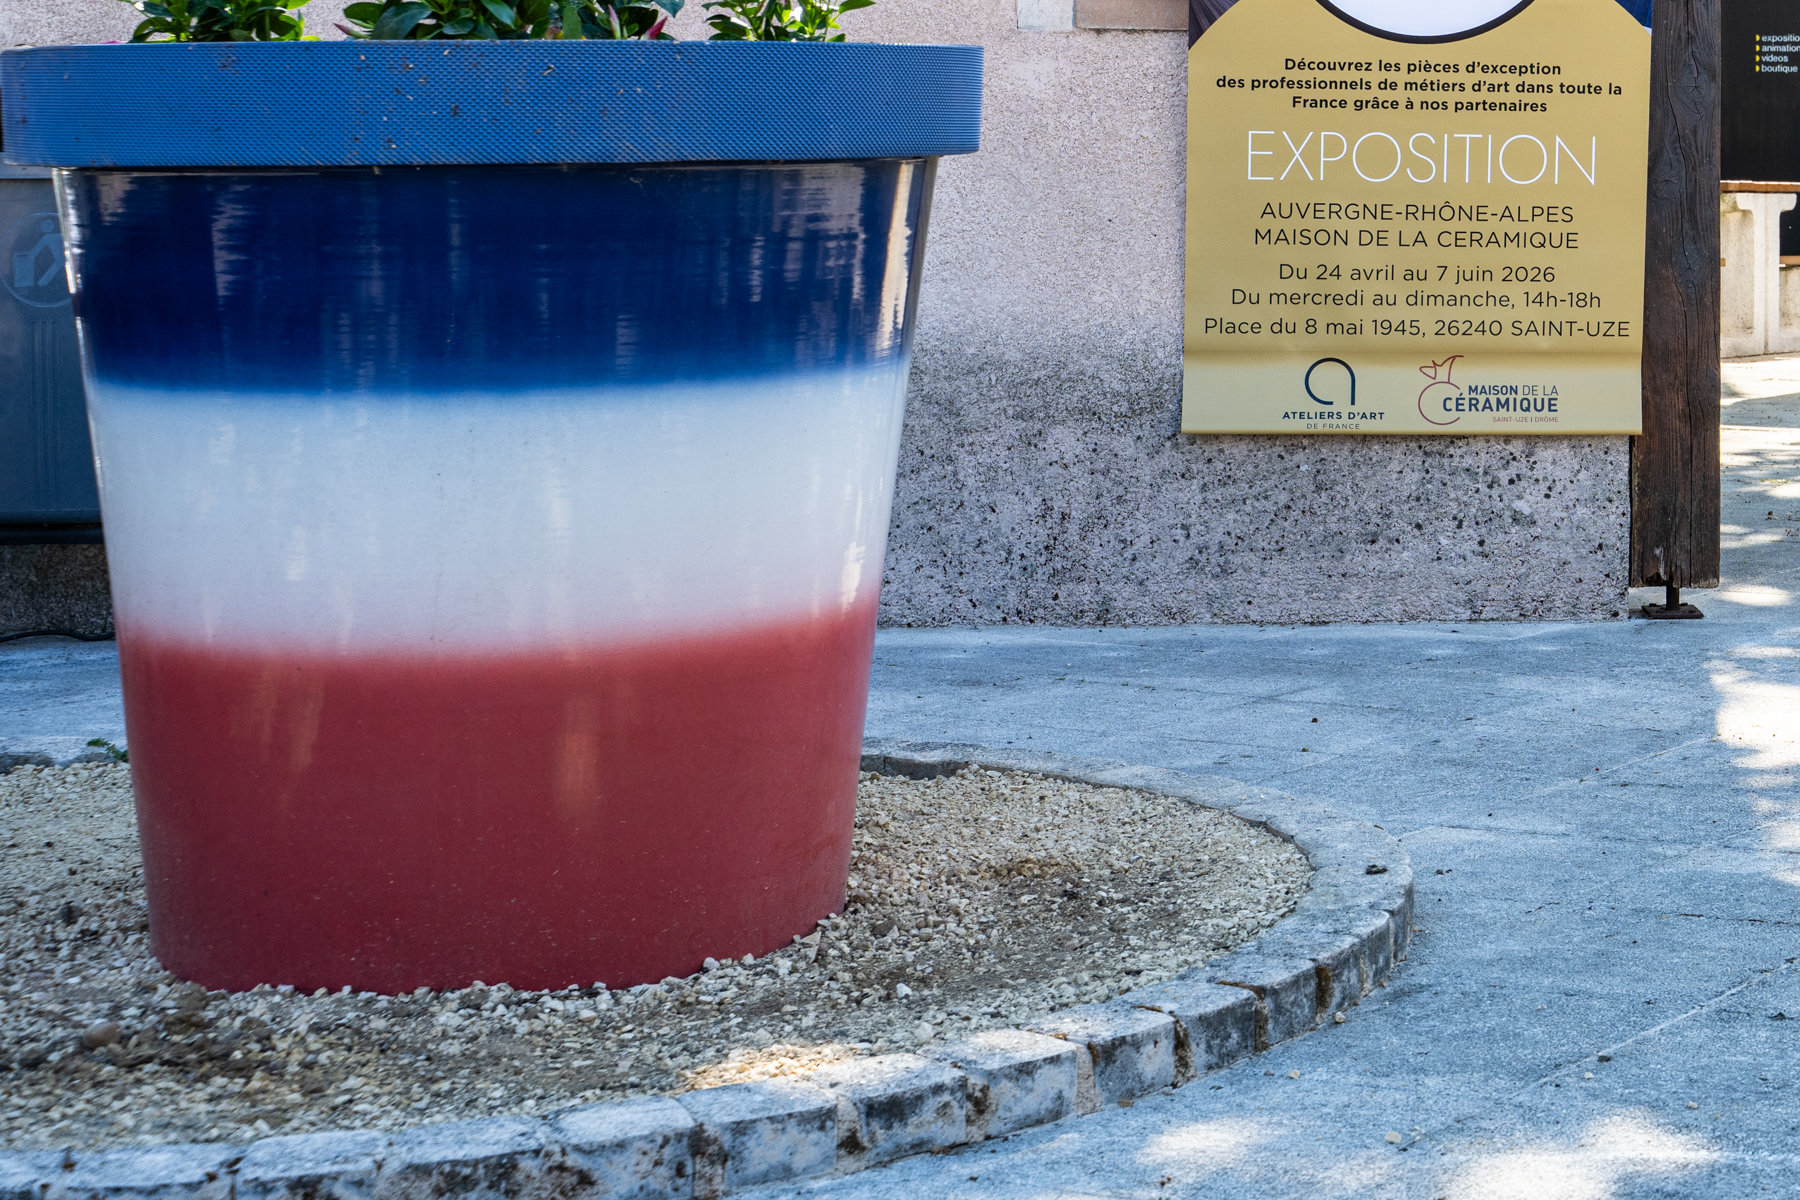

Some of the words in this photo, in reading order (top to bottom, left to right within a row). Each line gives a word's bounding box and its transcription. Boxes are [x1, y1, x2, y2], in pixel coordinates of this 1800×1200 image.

[1284, 58, 1373, 71] Découvrez
[1378, 60, 1401, 72] les
[1407, 59, 1460, 75] pièces
[1465, 61, 1561, 76] d'exception
[1761, 54, 1788, 62] videos
[1761, 64, 1798, 74] boutique
[1216, 76, 1244, 88] des
[1251, 76, 1372, 93] professionnels
[1378, 78, 1398, 91] de
[1404, 79, 1466, 92] métiers
[1471, 80, 1510, 93] d'art
[1516, 81, 1553, 93] dans
[1559, 82, 1602, 94] toute
[1608, 83, 1622, 95] la
[1292, 97, 1348, 109] France
[1353, 97, 1399, 113] grâce
[1405, 98, 1414, 110] à
[1420, 101, 1449, 111] nos
[1454, 100, 1547, 115] partenaires
[1247, 130, 1596, 186] EXPOSITION
[1260, 201, 1574, 223] AUVERGNE-RHÔNE-ALPES
[1255, 229, 1349, 247] MAISON
[1359, 230, 1389, 247] DE
[1398, 231, 1429, 248] LA
[1437, 231, 1579, 251] CERAMIQUE
[1279, 264, 1308, 280] Du
[1316, 264, 1342, 280] 24
[1349, 265, 1395, 281] avril
[1403, 268, 1428, 282] au
[1437, 266, 1447, 282] 7
[1455, 266, 1493, 285] juin
[1501, 266, 1555, 283] 2026
[1232, 288, 1260, 305] Du
[1268, 288, 1364, 306] mercredi
[1373, 293, 1397, 306] au
[1405, 290, 1516, 309] dimanche,
[1523, 291, 1601, 308] 14h-18h
[1204, 318, 1262, 335] Place
[1271, 318, 1296, 335] du
[1305, 319, 1317, 335] 8
[1326, 319, 1363, 336] mai
[1372, 319, 1426, 339] 1945,
[1434, 320, 1502, 337] 26240
[1511, 321, 1630, 337] SAINT-UZE
[1468, 385, 1518, 395] MAISON
[1523, 385, 1539, 395] DE
[1543, 386, 1558, 395] LA
[1443, 393, 1558, 412] CÉRAMIQUE
